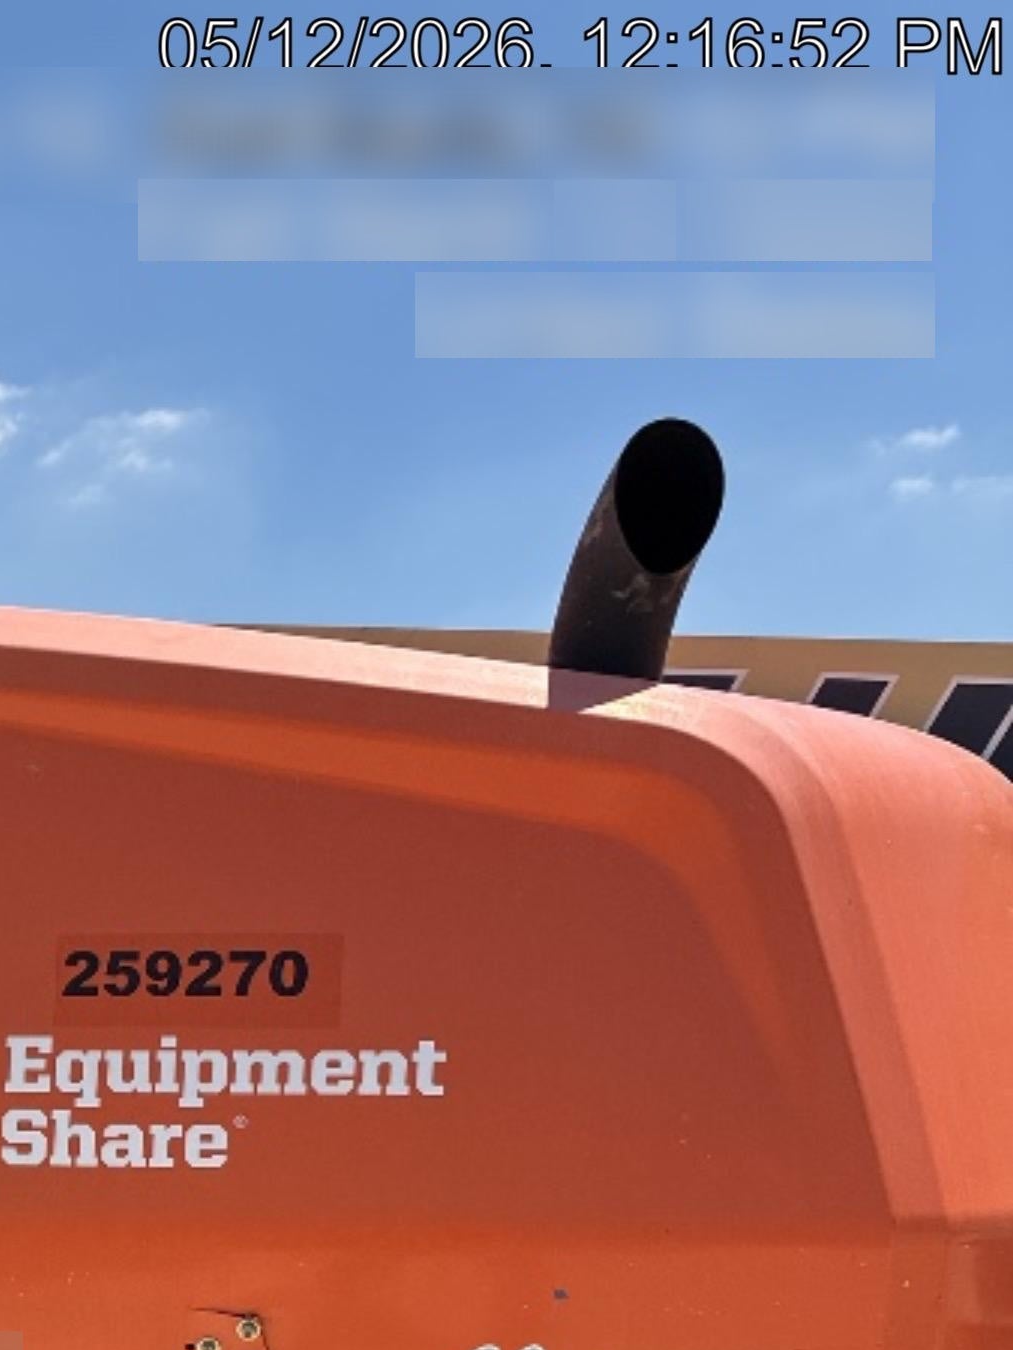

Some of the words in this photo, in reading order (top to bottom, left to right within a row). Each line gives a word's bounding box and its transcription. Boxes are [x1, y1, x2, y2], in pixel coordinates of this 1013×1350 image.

[62, 950, 309, 997] 259270
[3, 1034, 447, 1108] Equipment
[0, 1108, 229, 1168] Share
